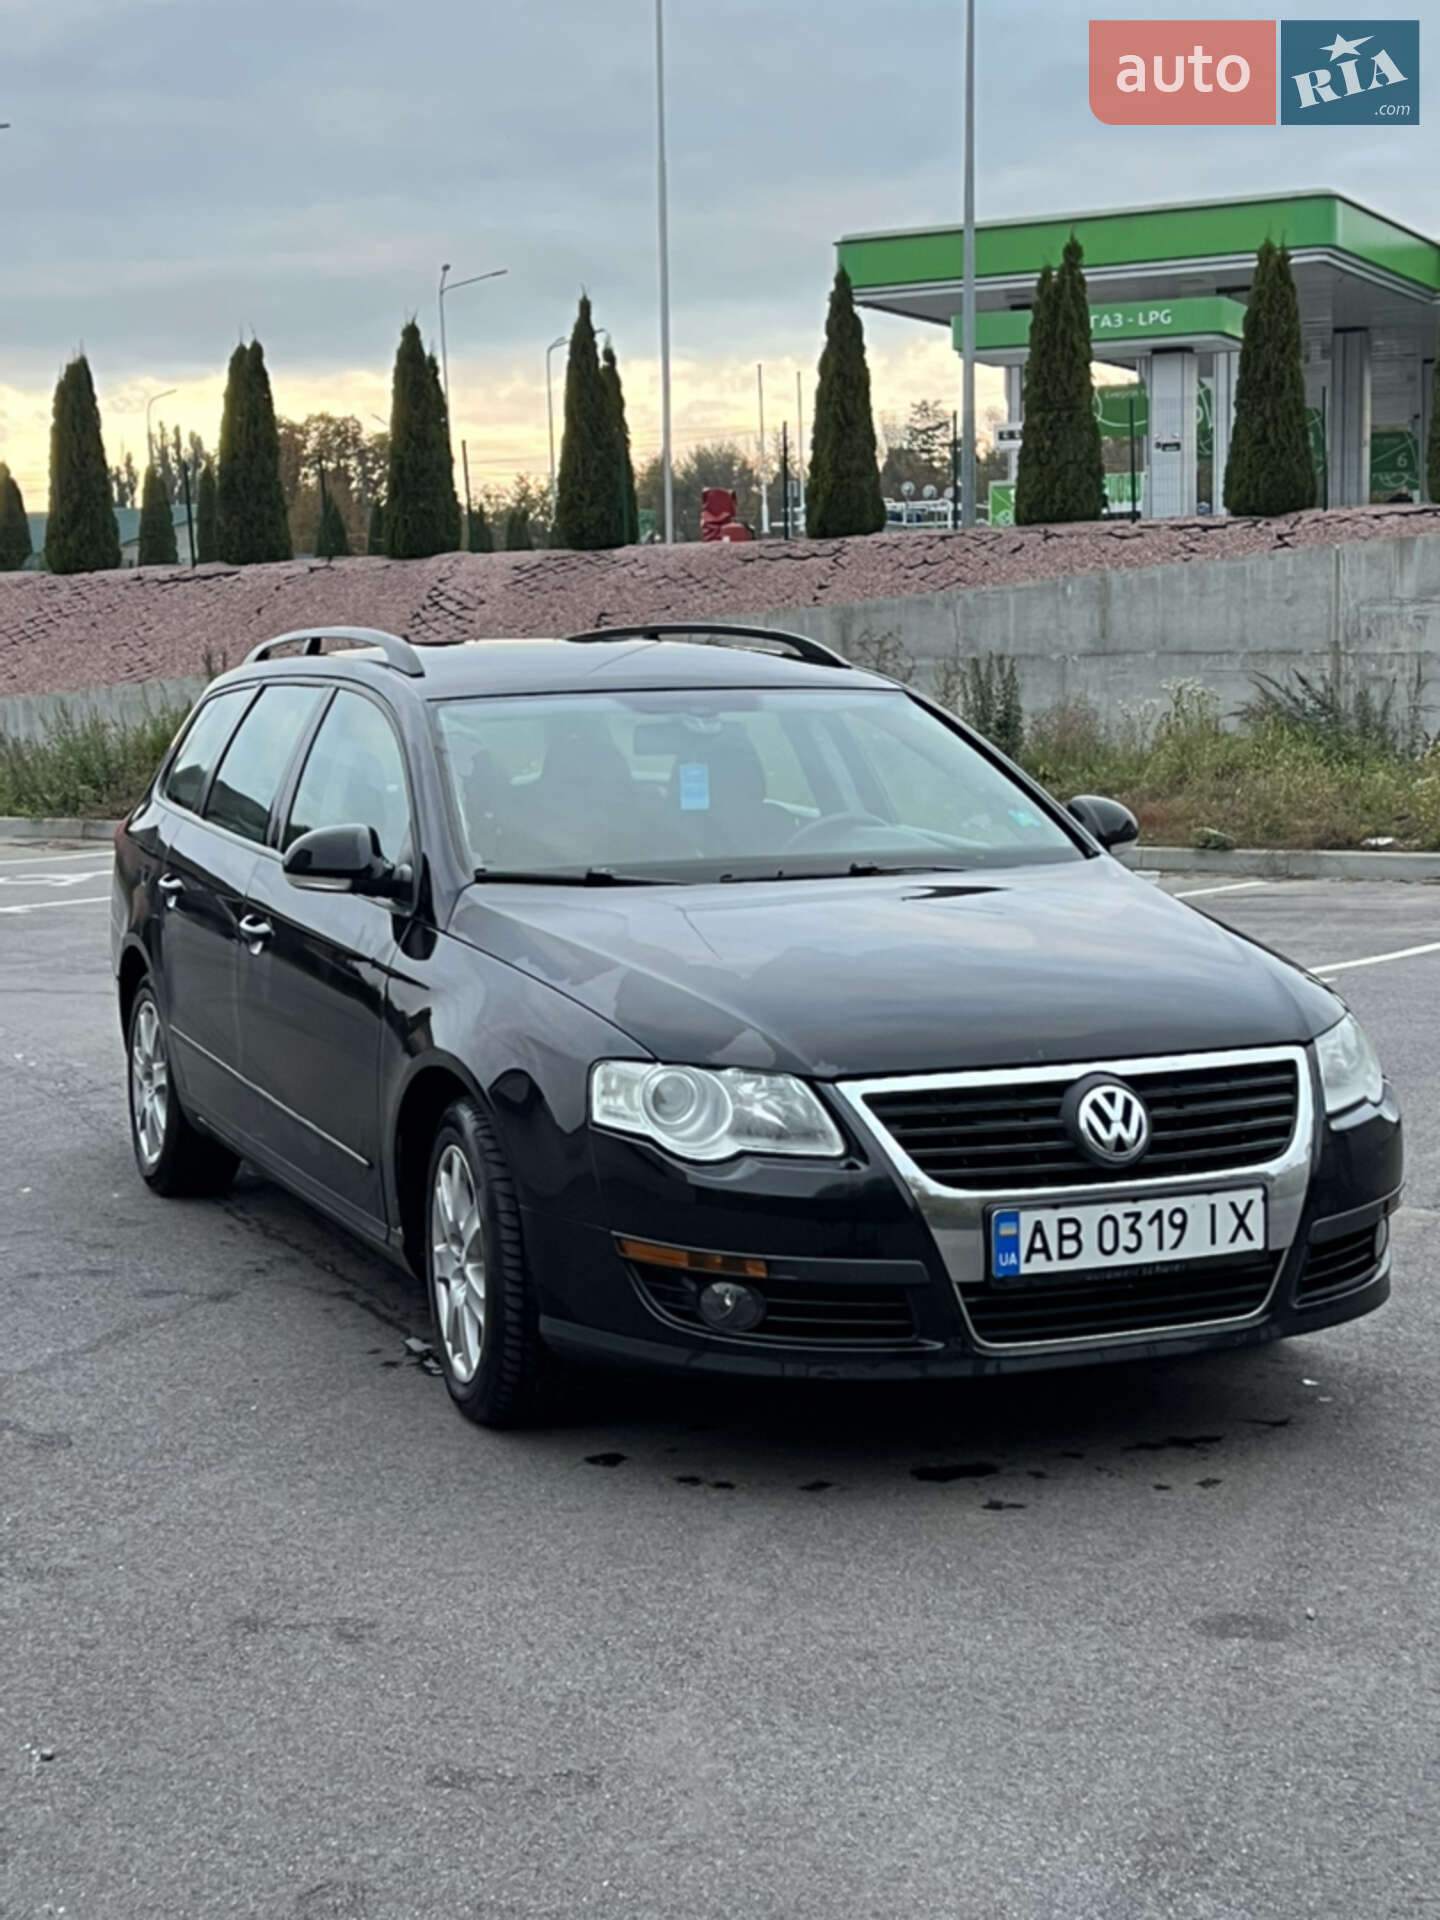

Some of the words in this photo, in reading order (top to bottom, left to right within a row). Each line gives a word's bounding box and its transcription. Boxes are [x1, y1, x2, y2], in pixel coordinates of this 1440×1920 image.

[1090, 313, 1123, 329] ГАЗ
[1138, 308, 1172, 326] LPG
[1024, 1217, 1083, 1264] AB
[1097, 1207, 1188, 1257] 0319
[1209, 1199, 1255, 1246] IX
[999, 1252, 1018, 1267] UA
